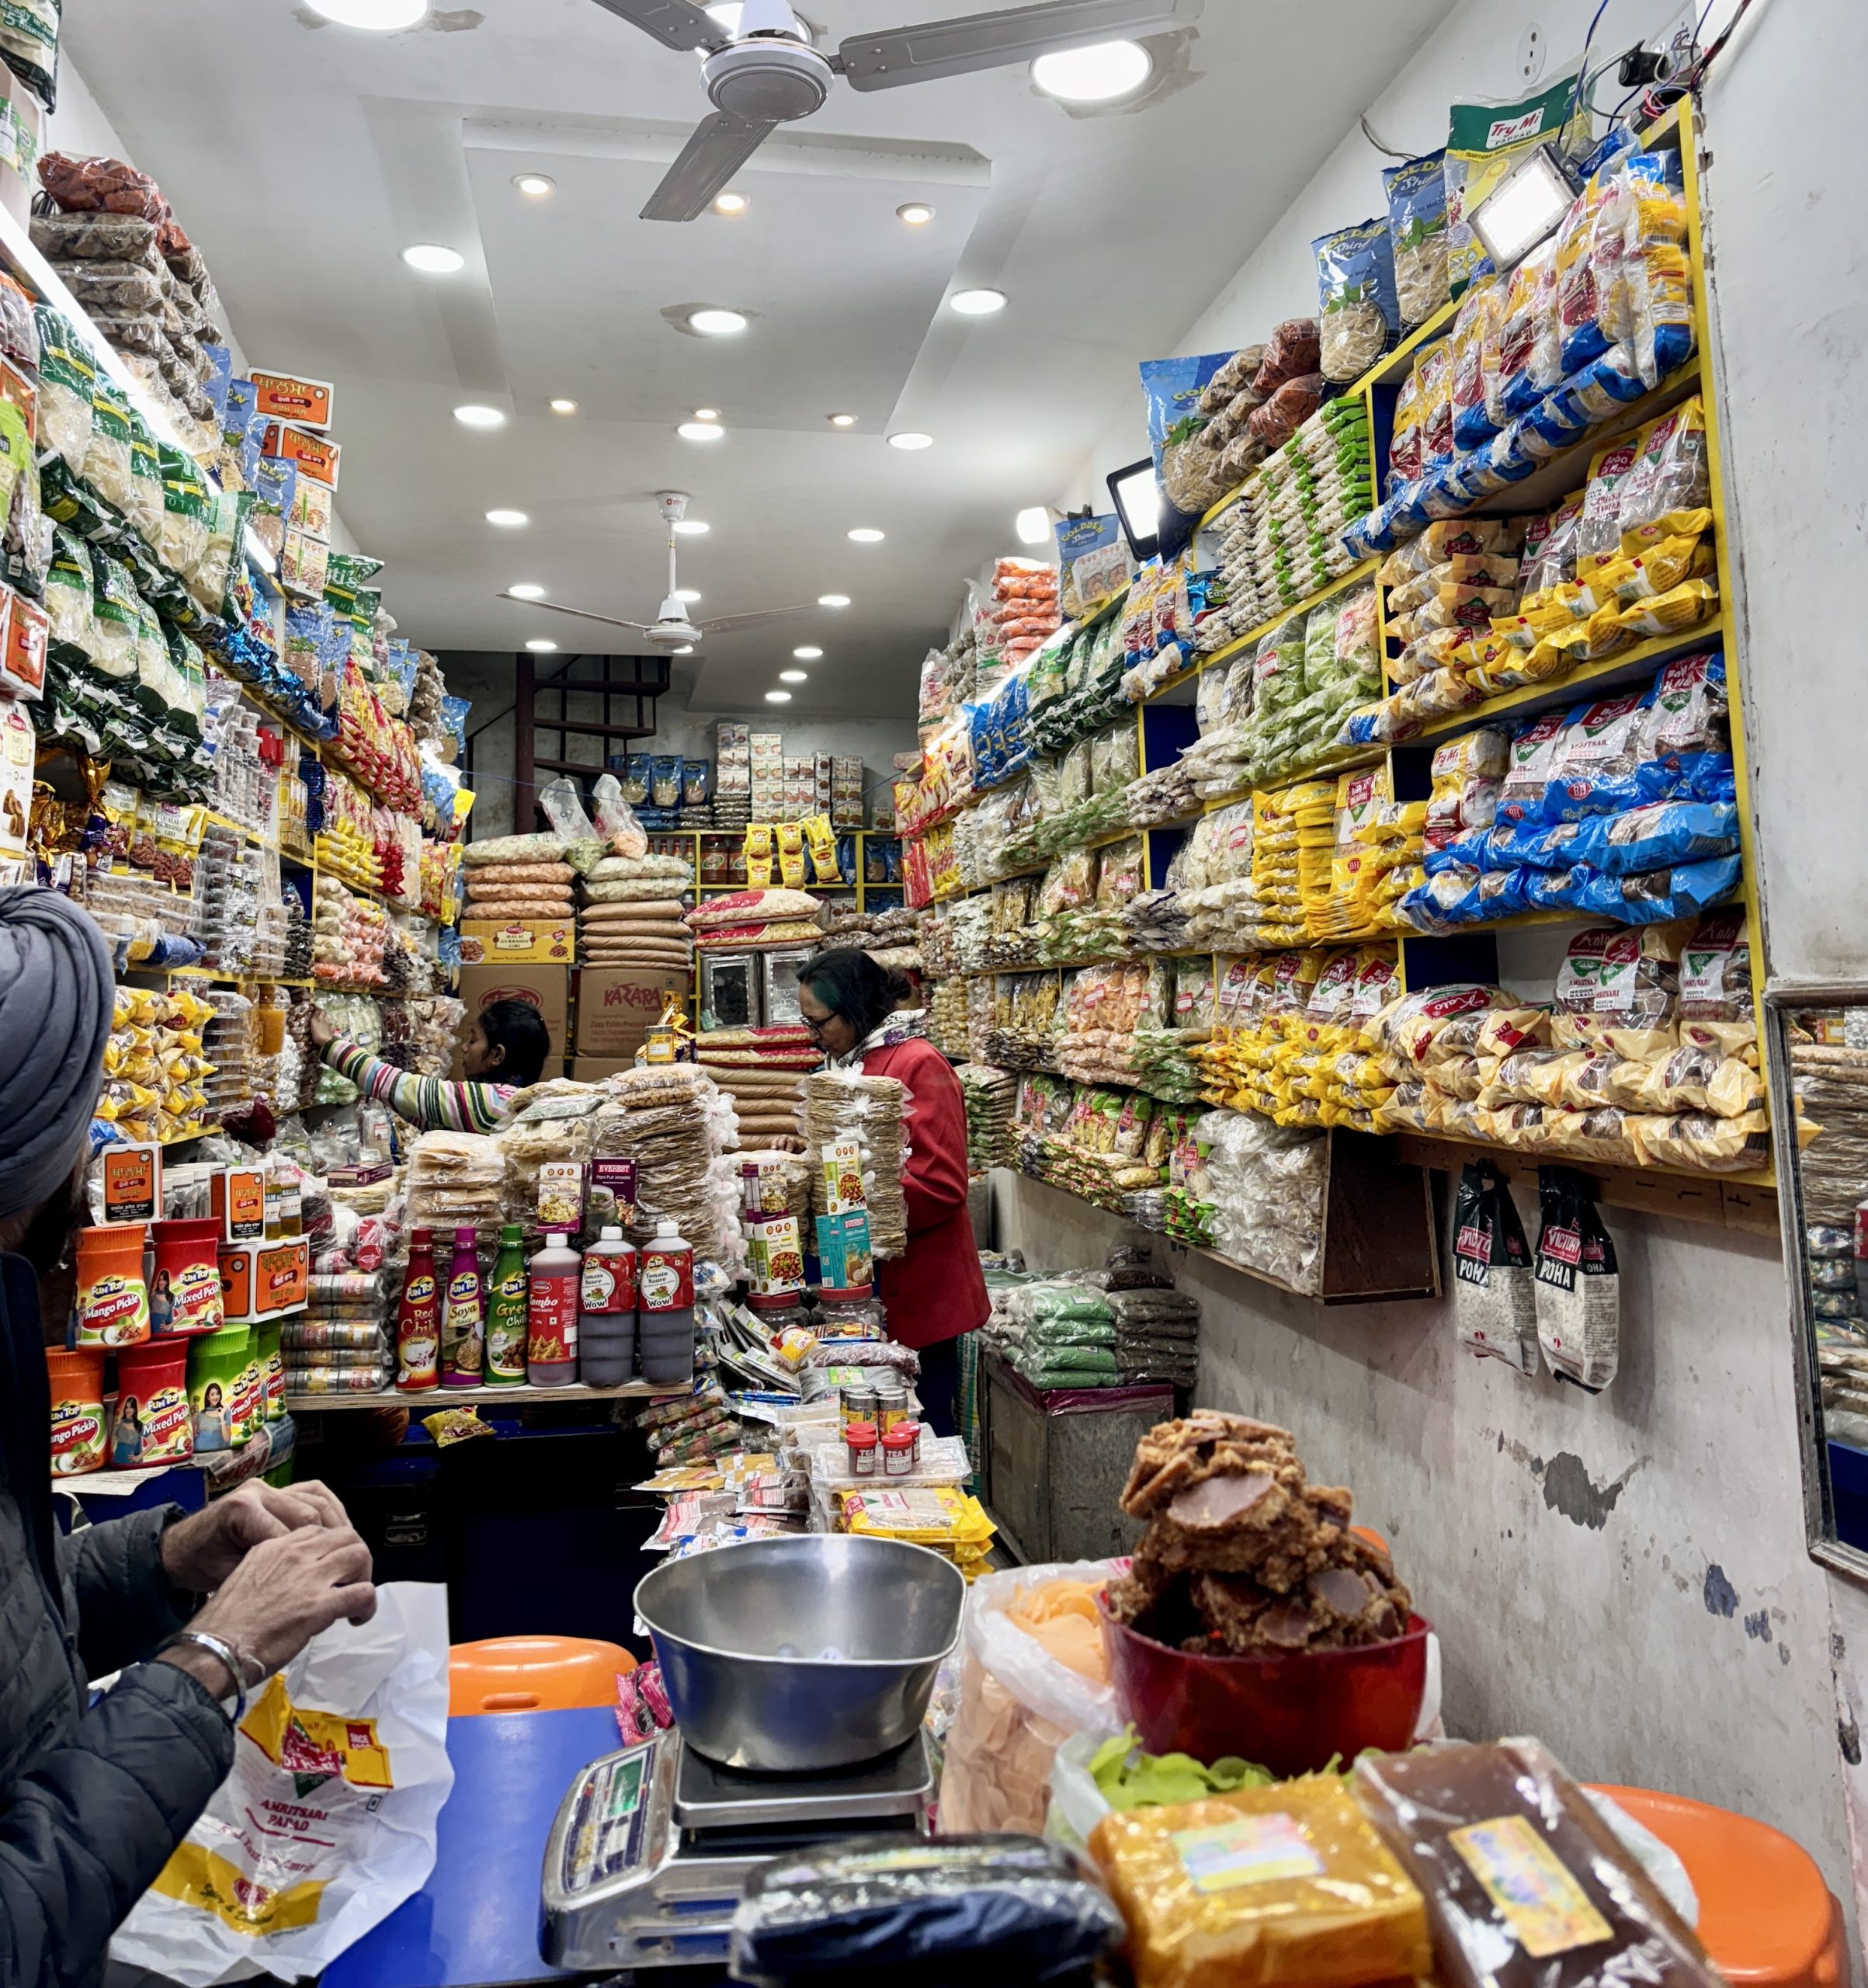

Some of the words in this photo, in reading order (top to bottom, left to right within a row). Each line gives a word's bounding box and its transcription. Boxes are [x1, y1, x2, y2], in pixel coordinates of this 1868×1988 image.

[1, 1, 32, 22] Ready
[1491, 123, 1517, 138] Try
[1519, 111, 1542, 130] Mi
[1495, 130, 1532, 145] PAPPAD
[1061, 521, 1106, 543] GOLDDEN
[1434, 750, 1447, 767] Try
[1447, 749, 1459, 761] Mi
[1349, 861, 1359, 871] BH
[597, 1164, 630, 1173] EVEREST
[1549, 1227, 1581, 1255] VICTORY
[179, 1272, 196, 1283] FUN
[196, 1268, 210, 1280] TOP
[1460, 1260, 1489, 1286] POHA
[1539, 1260, 1571, 1288] POHA
[1587, 1263, 1606, 1274] OHA
[91, 1285, 108, 1297] FUN
[108, 1281, 125, 1291] TOP
[407, 1284, 421, 1298] FUN
[420, 1282, 435, 1294] TOP
[450, 1283, 465, 1295] FUN
[464, 1279, 478, 1289] TOP
[502, 1281, 519, 1293] FUN
[517, 1278, 526, 1288] TO
[85, 1304, 116, 1319] Mango
[116, 1295, 138, 1309] Pickle
[175, 1291, 203, 1307] Mixed
[529, 1295, 560, 1308] Tombo
[583, 1296, 608, 1309] Wow!
[647, 1296, 673, 1309] Wow!
[413, 1307, 434, 1321] Red
[450, 1304, 478, 1319] Soya
[496, 1302, 526, 1318] Gree
[506, 1315, 527, 1327] Chill
[266, 1361, 279, 1371] FUN
[229, 1383, 243, 1394] FUN
[148, 1399, 165, 1411] FUN
[165, 1393, 179, 1405] TOP
[64, 1406, 80, 1416] TOP
[51, 1431, 71, 1443] ngo
[71, 1420, 95, 1437] Pickle
[143, 1419, 174, 1436] Mixed
[350, 1733, 370, 1744] SINCE
[283, 1753, 297, 1767] Di
[260, 1799, 329, 1821] AMRITSARI
[267, 1814, 310, 1832] PAPAD
